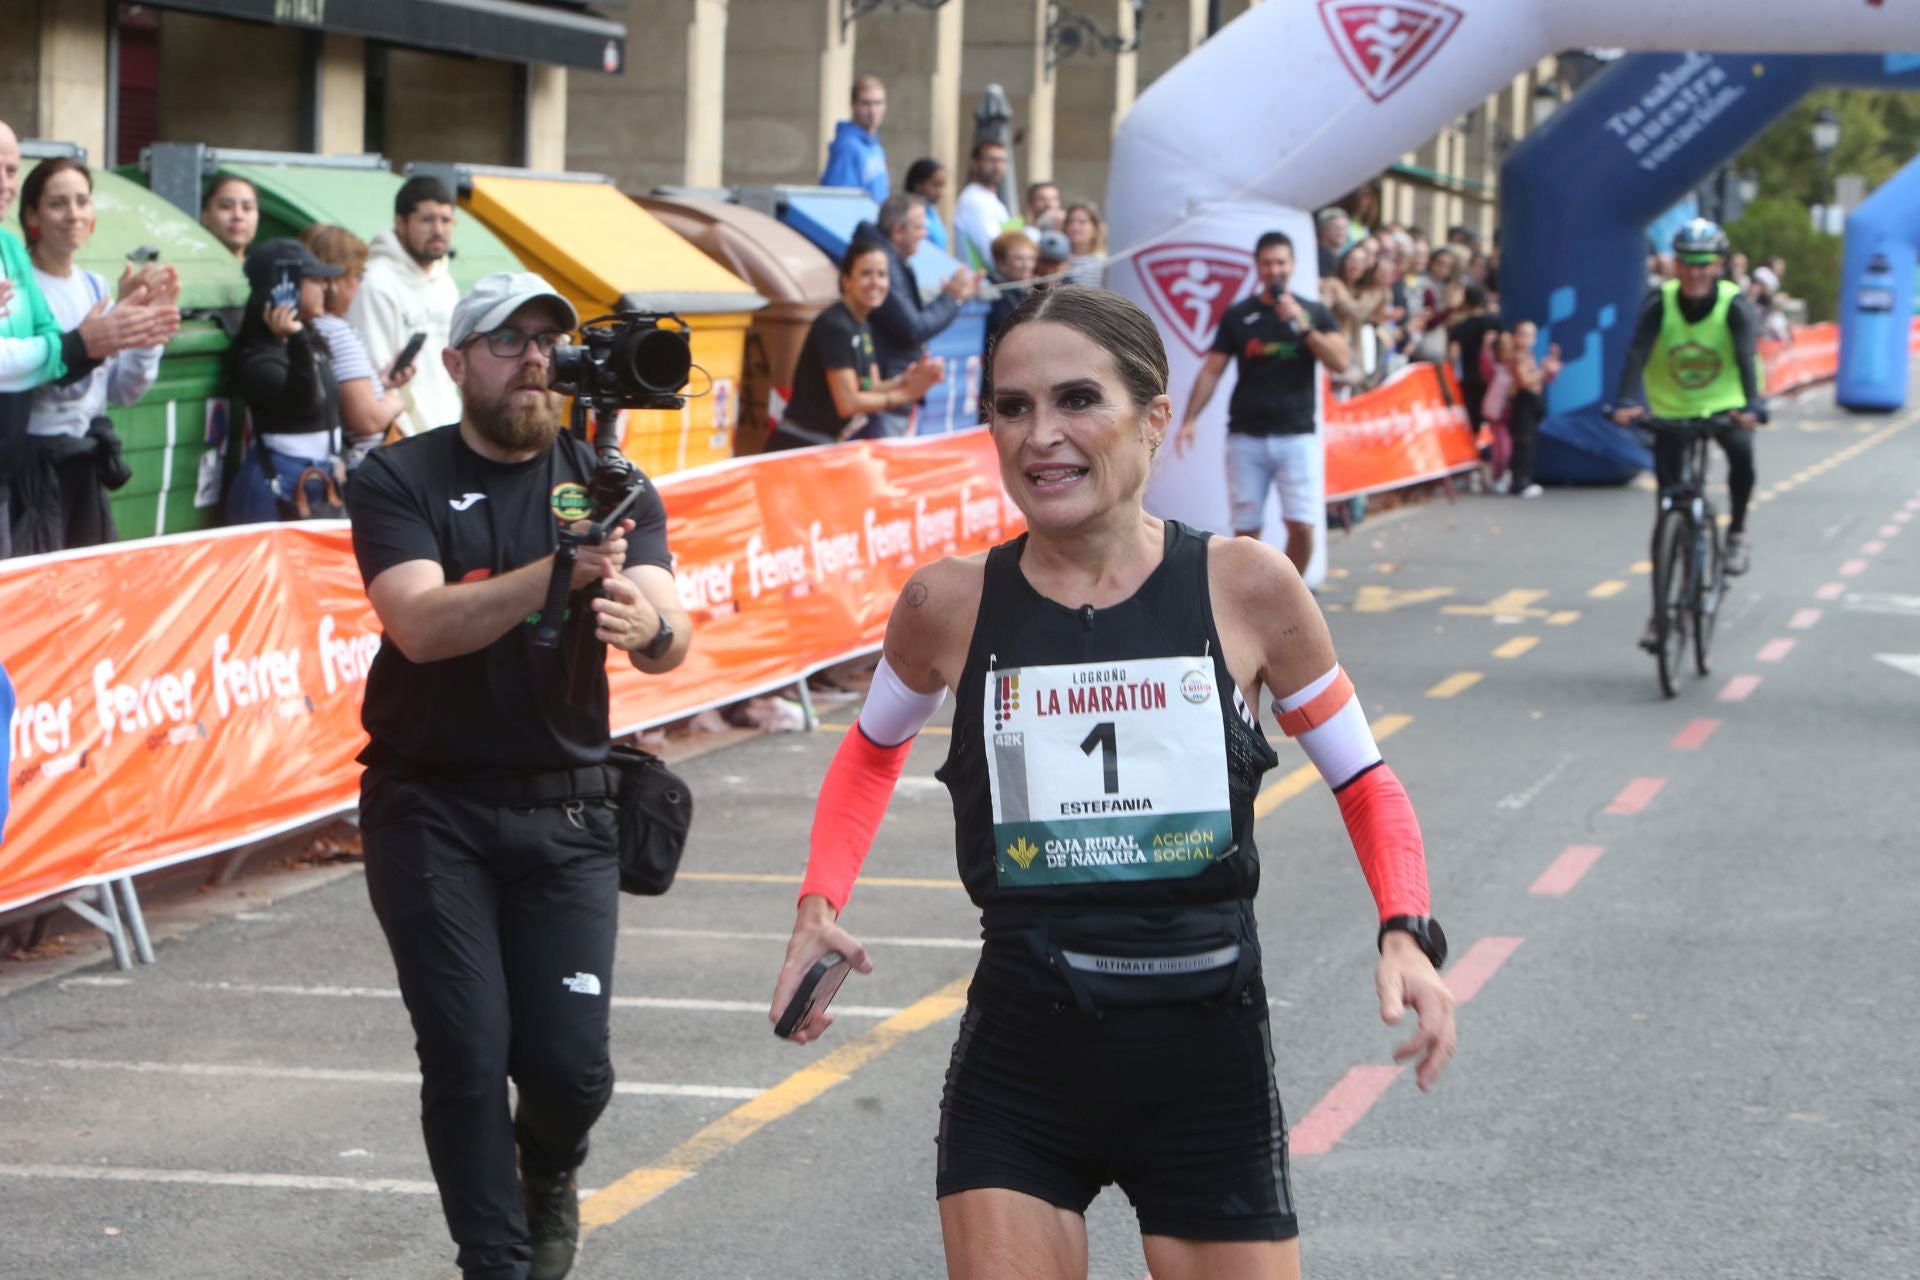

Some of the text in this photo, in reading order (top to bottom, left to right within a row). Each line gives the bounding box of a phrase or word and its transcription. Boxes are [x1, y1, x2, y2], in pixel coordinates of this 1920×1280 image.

[671, 552, 734, 610] errer
[1072, 668, 1127, 684] LOGROÑO
[1036, 678, 1167, 716] LA MARATÓN
[10, 697, 72, 762] rrer
[995, 734, 1022, 747] 42K
[1080, 722, 1119, 795] 1
[1060, 798, 1153, 815] ESTEFANIA
[1045, 835, 1139, 854] CAJA RURAL
[1153, 828, 1214, 847] ACCIÓN
[1046, 849, 1147, 868] DE NAVARRA
[1153, 848, 1214, 863] SOCIAL
[1096, 956, 1215, 972] ULTIMATE DIRECTION
